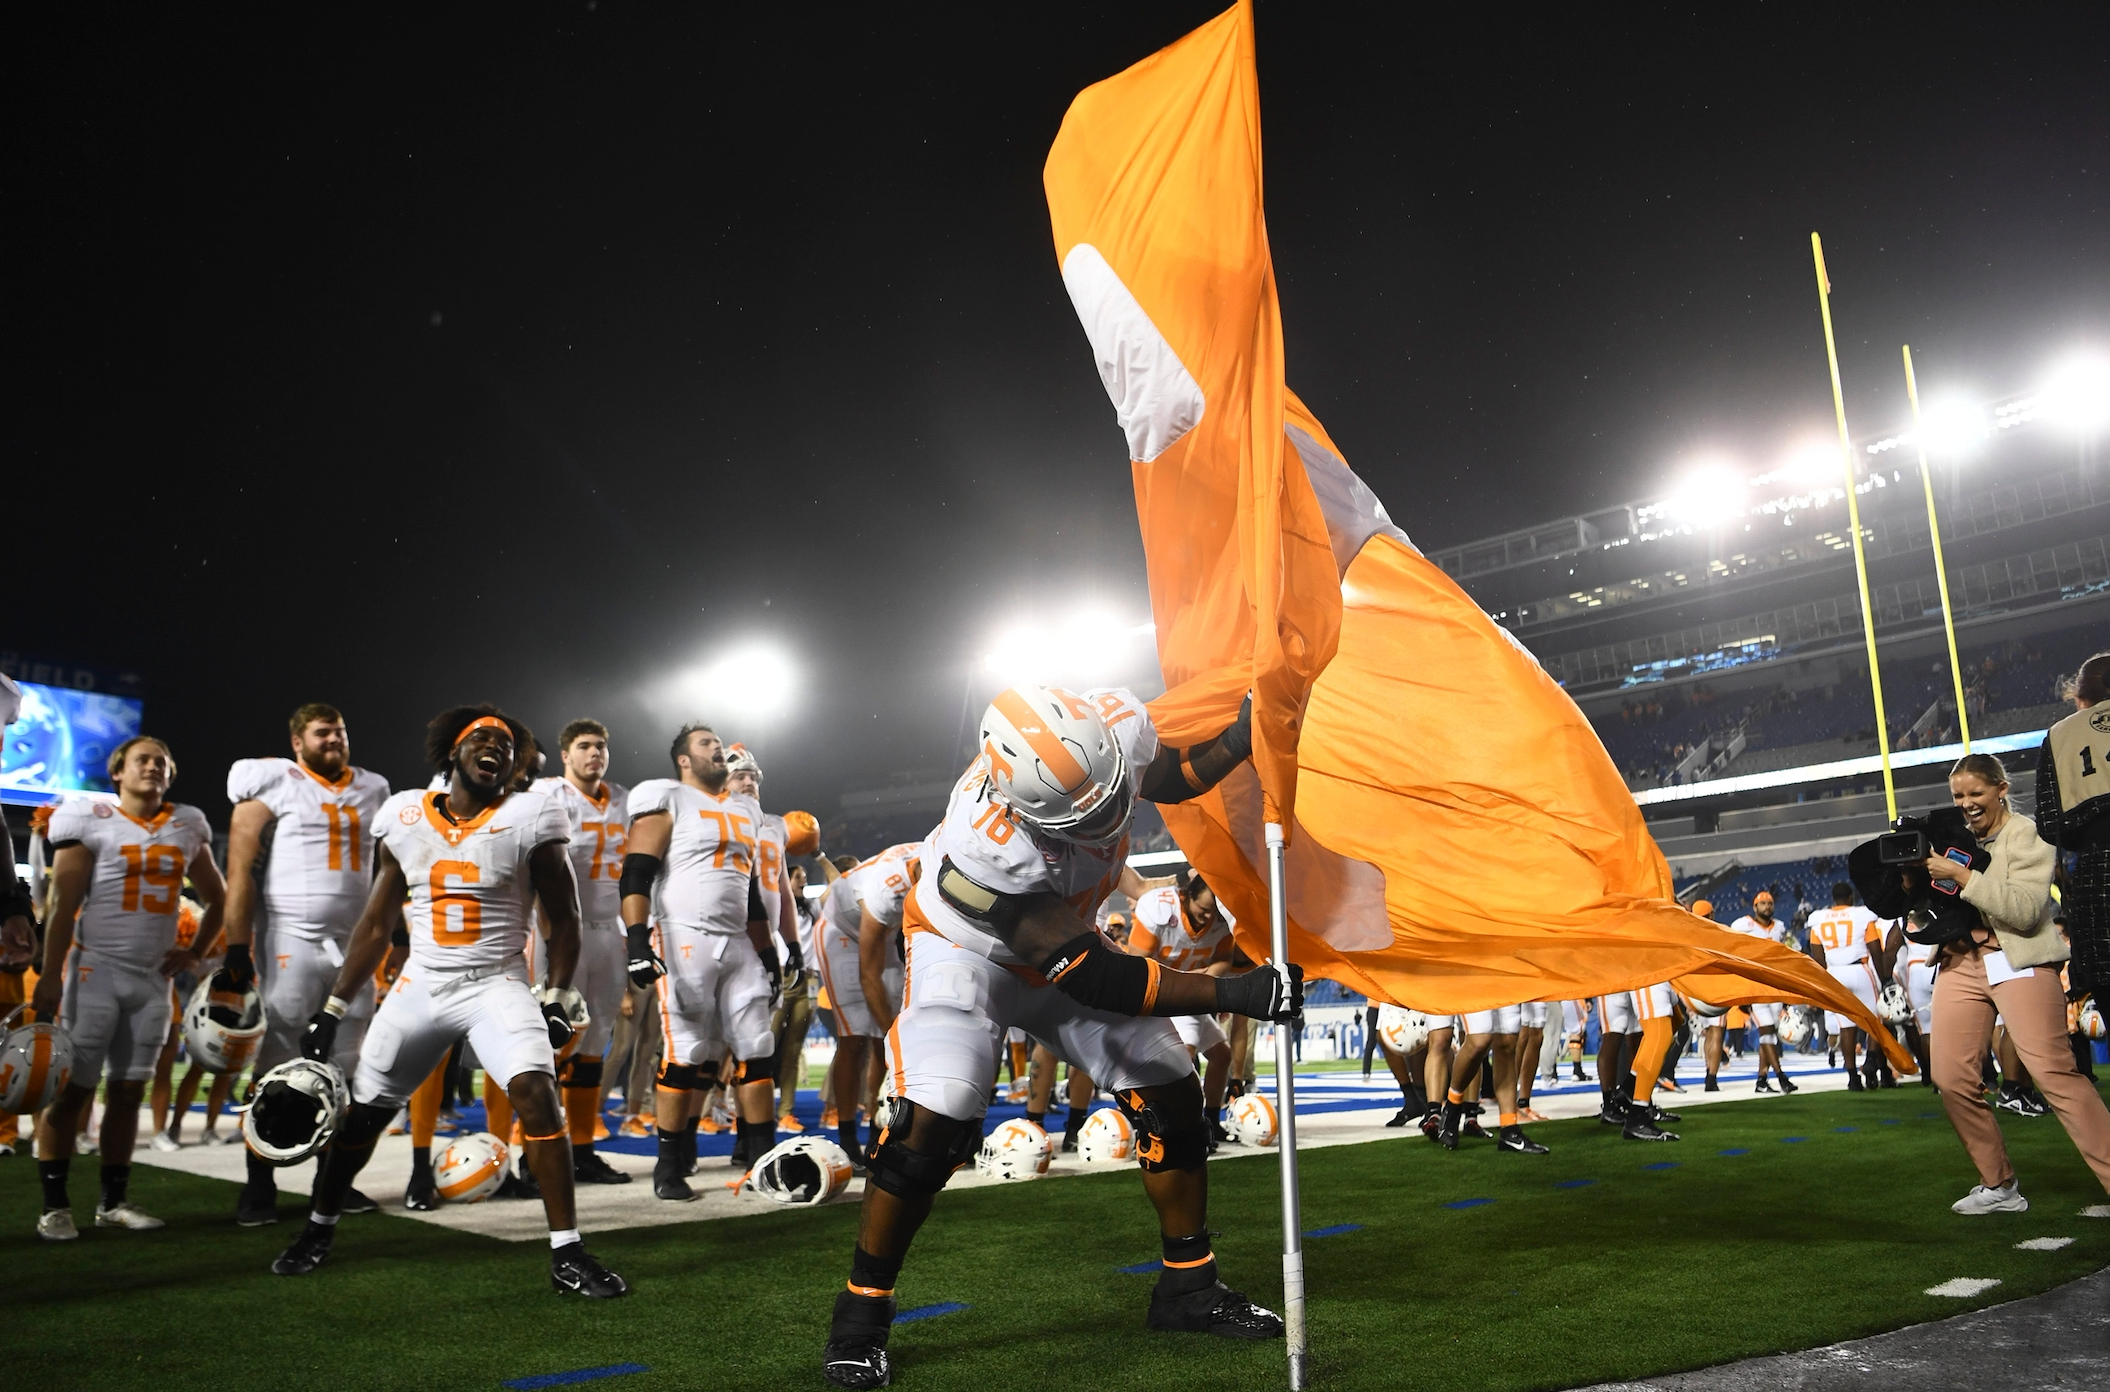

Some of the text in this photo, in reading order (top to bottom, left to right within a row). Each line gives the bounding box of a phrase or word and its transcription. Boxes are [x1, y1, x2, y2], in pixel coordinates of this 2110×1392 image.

[1076, 786, 1104, 813] VOLS
[401, 807, 421, 825] SEC
[321, 802, 361, 873] 11
[447, 828, 463, 843] T
[699, 809, 757, 875] 75
[581, 821, 629, 881] 73
[120, 844, 184, 914] 19
[884, 873, 909, 895] 87
[429, 859, 481, 947] 6
[838, 937, 850, 949] T
[1820, 919, 1854, 951] 97
[274, 953, 292, 969] T
[680, 944, 694, 959] T
[76, 966, 94, 982] T
[395, 974, 412, 994] T
[927, 963, 974, 1000] T
[1237, 1102, 1259, 1124] T
[1084, 1114, 1105, 1137] T
[1003, 1126, 1028, 1148] T
